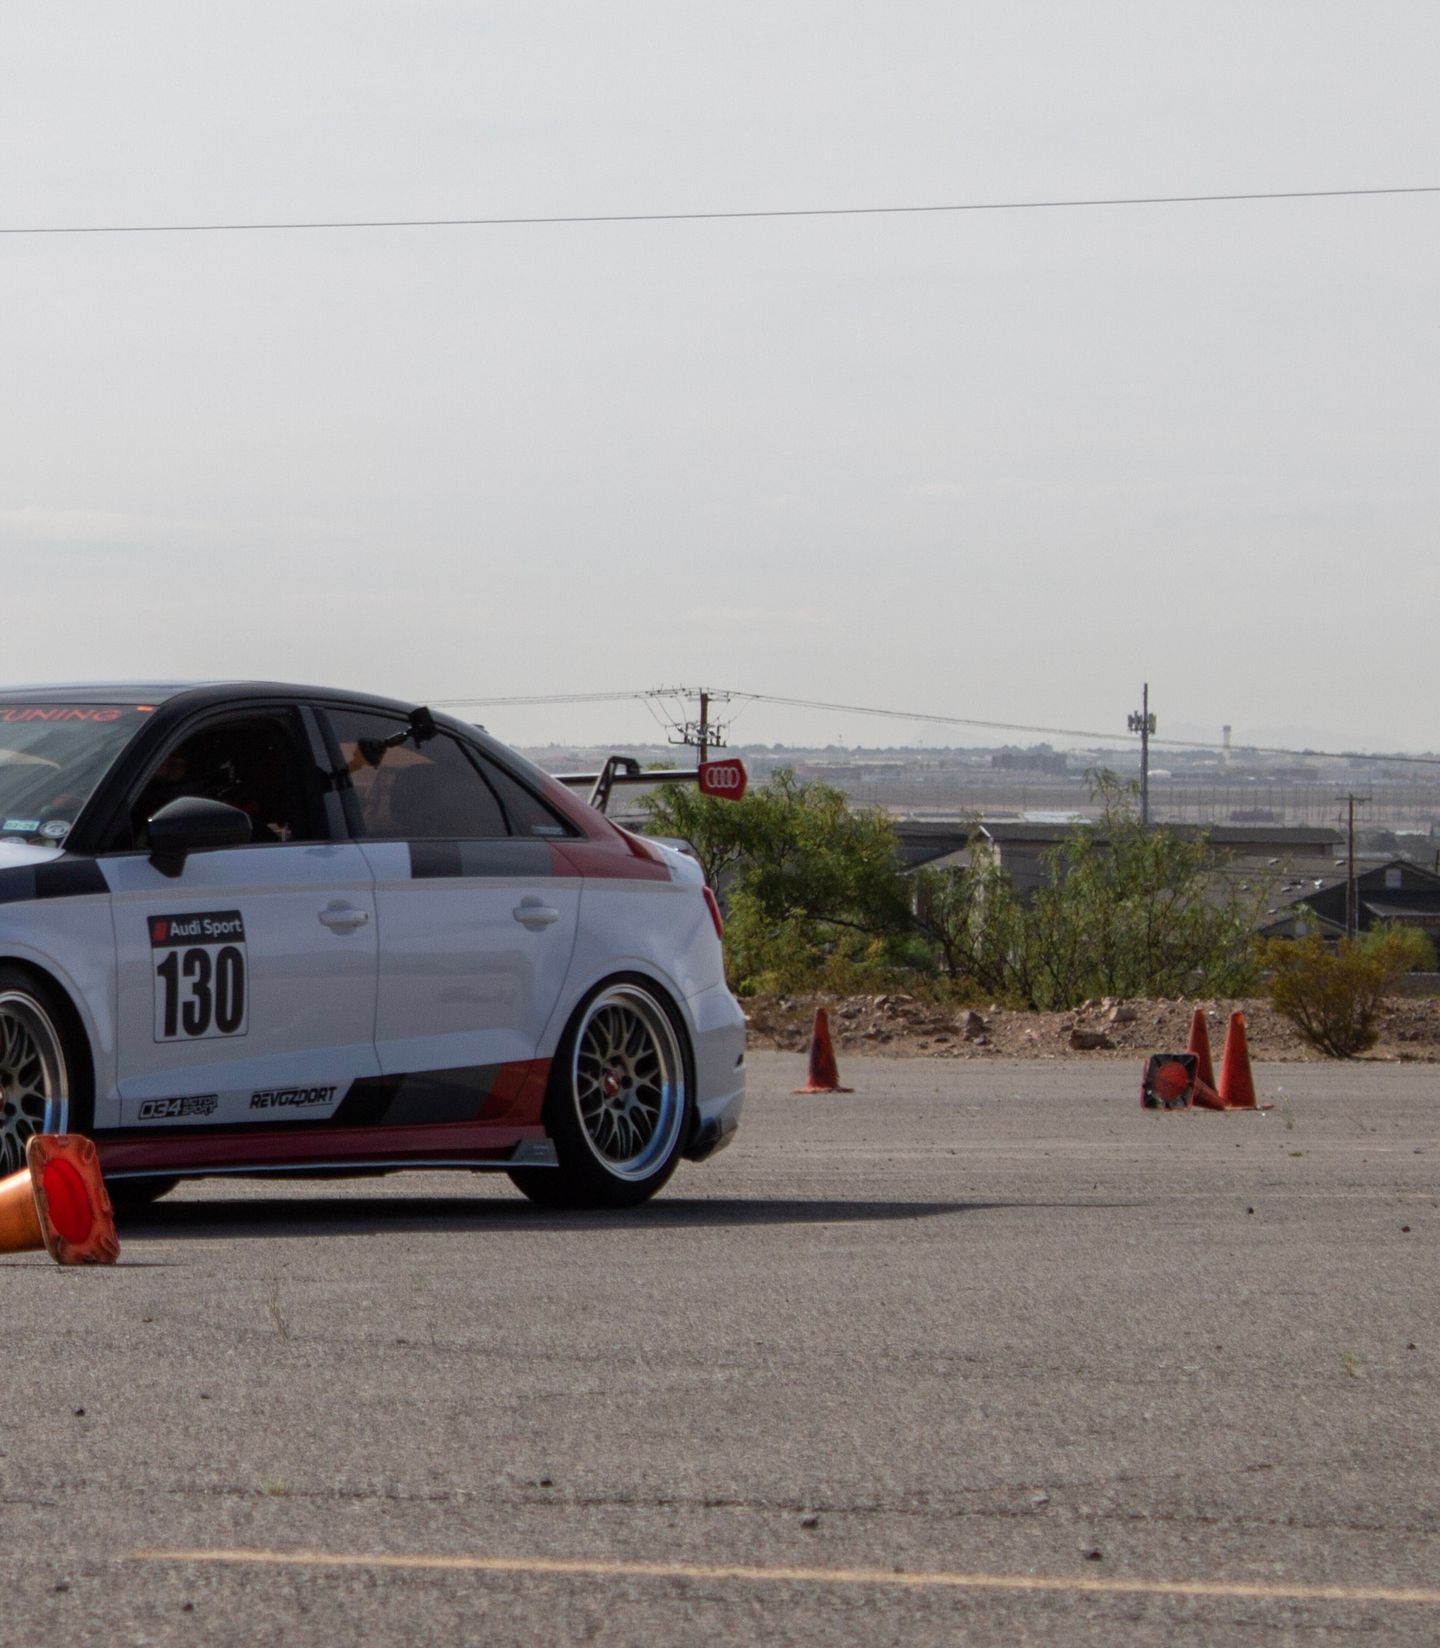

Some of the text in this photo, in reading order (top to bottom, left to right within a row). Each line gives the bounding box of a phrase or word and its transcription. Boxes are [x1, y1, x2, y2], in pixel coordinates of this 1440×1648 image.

[170, 919, 243, 937] Audi Sport
[157, 946, 244, 1037] 130
[140, 1099, 182, 1119] 034
